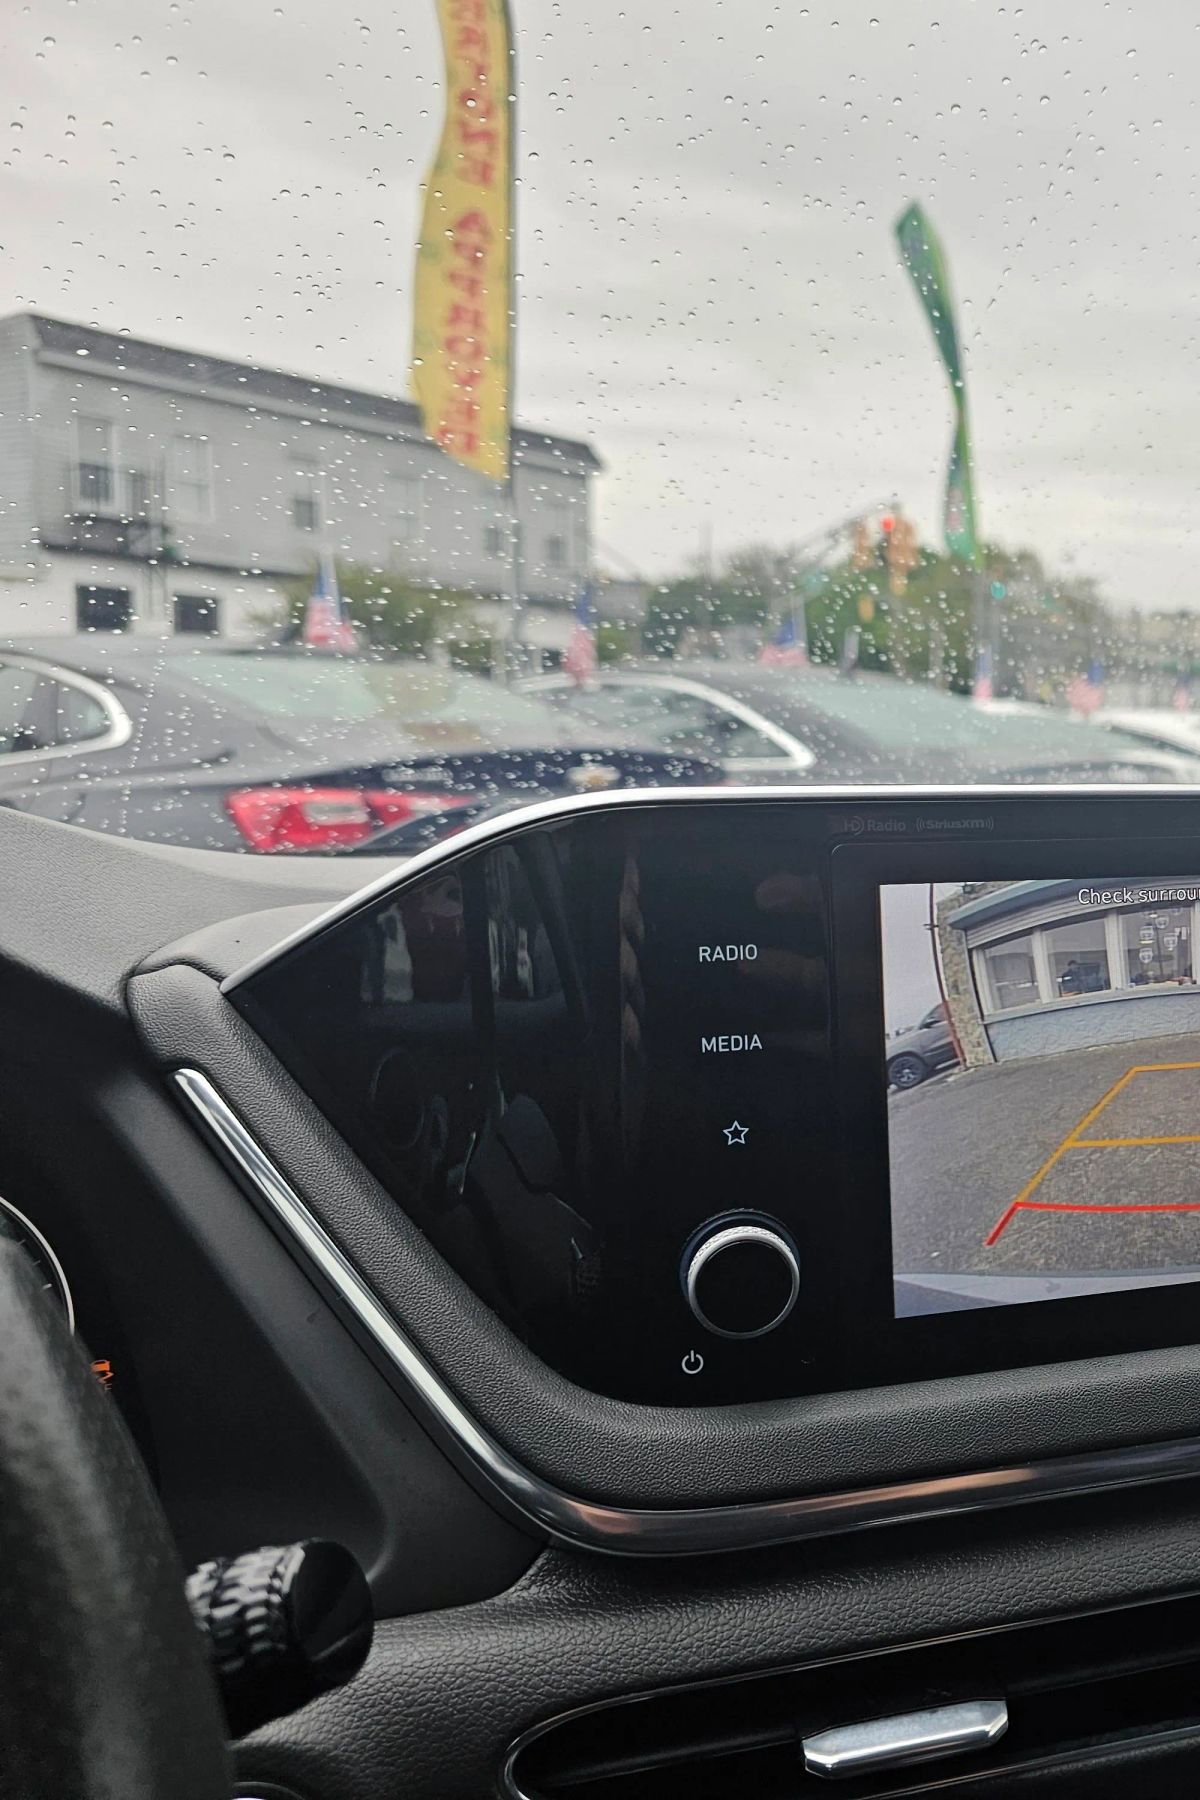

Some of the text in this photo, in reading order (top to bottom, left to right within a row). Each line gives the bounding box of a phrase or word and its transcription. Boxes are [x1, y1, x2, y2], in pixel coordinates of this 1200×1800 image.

[867, 819, 906, 832] Radio
[1078, 887, 1134, 904] Check
[698, 943, 758, 963] RADIO
[701, 1034, 763, 1053] MEDIA
